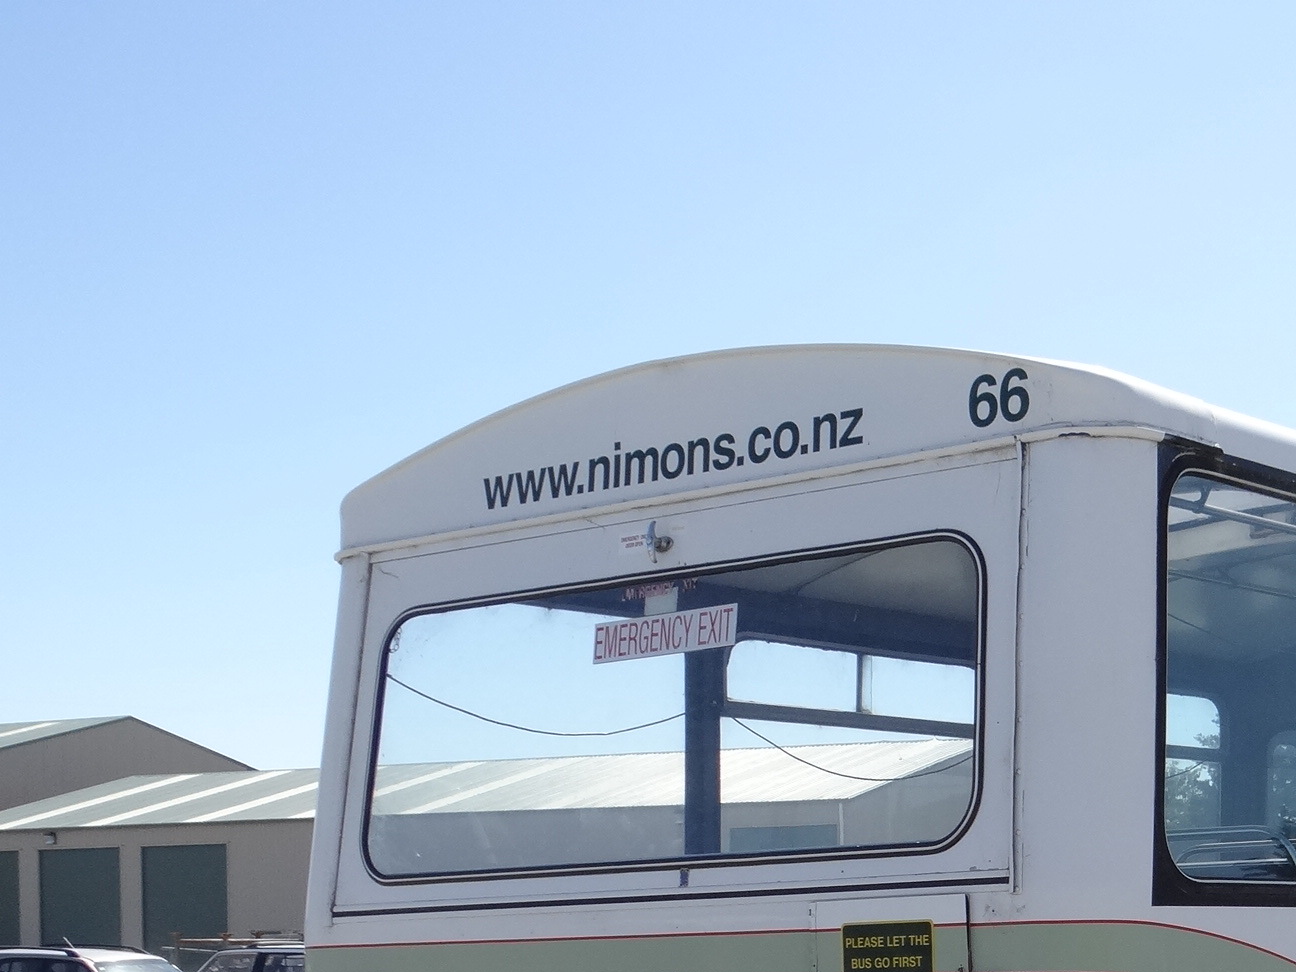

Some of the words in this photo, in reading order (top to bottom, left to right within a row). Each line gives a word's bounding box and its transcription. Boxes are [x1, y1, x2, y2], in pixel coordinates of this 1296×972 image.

[967, 367, 1031, 429] 66
[484, 406, 865, 510] www.nimons.co.nz
[594, 614, 694, 660] EMERGENCY
[697, 607, 734, 646] EXIT
[845, 936, 885, 949] PLEASE
[886, 935, 907, 948] LET
[908, 934, 930, 947] THE
[851, 957, 872, 970] BUS
[874, 956, 890, 969] GO
[892, 955, 923, 968] FIRST
